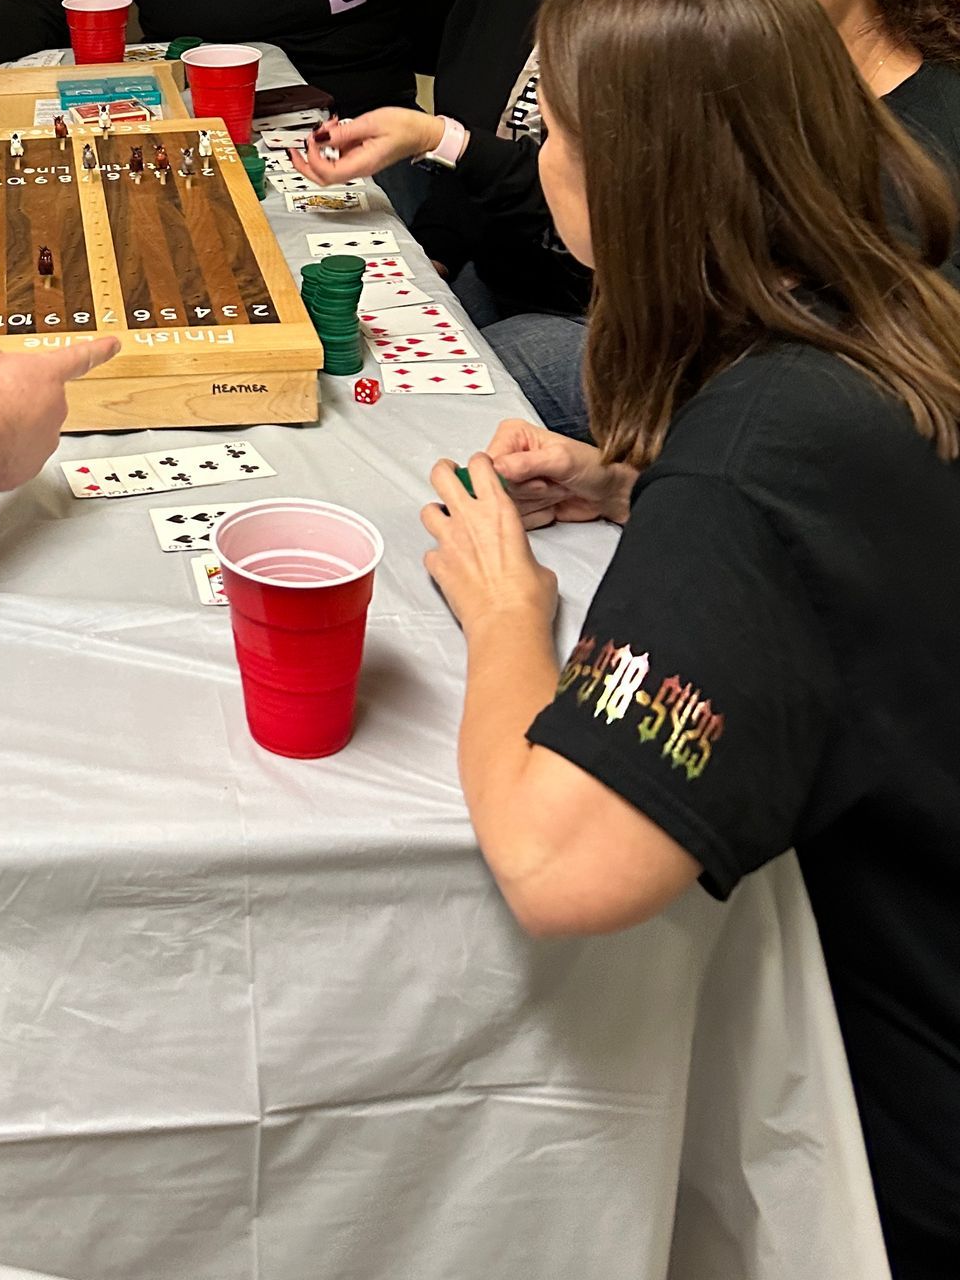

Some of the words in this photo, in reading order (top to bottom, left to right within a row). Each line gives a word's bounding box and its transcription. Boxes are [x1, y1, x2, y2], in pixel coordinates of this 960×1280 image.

[106, 172, 120, 181] 6
[201, 168, 215, 177] 2
[7, 177, 27, 186] 10
[34, 176, 48, 185] 9
[58, 175, 72, 183] 8
[102, 310, 119, 323] 7
[133, 309, 151, 321] 6
[160, 308, 178, 320] 5
[193, 306, 212, 319] 4
[221, 305, 239, 317] 3
[252, 304, 270, 317] 2
[7, 313, 33, 326] 10
[44, 312, 61, 325] 9
[72, 311, 90, 324] 8
[134, 328, 235, 347] Finish
[212, 383, 269, 396] HEATHER
